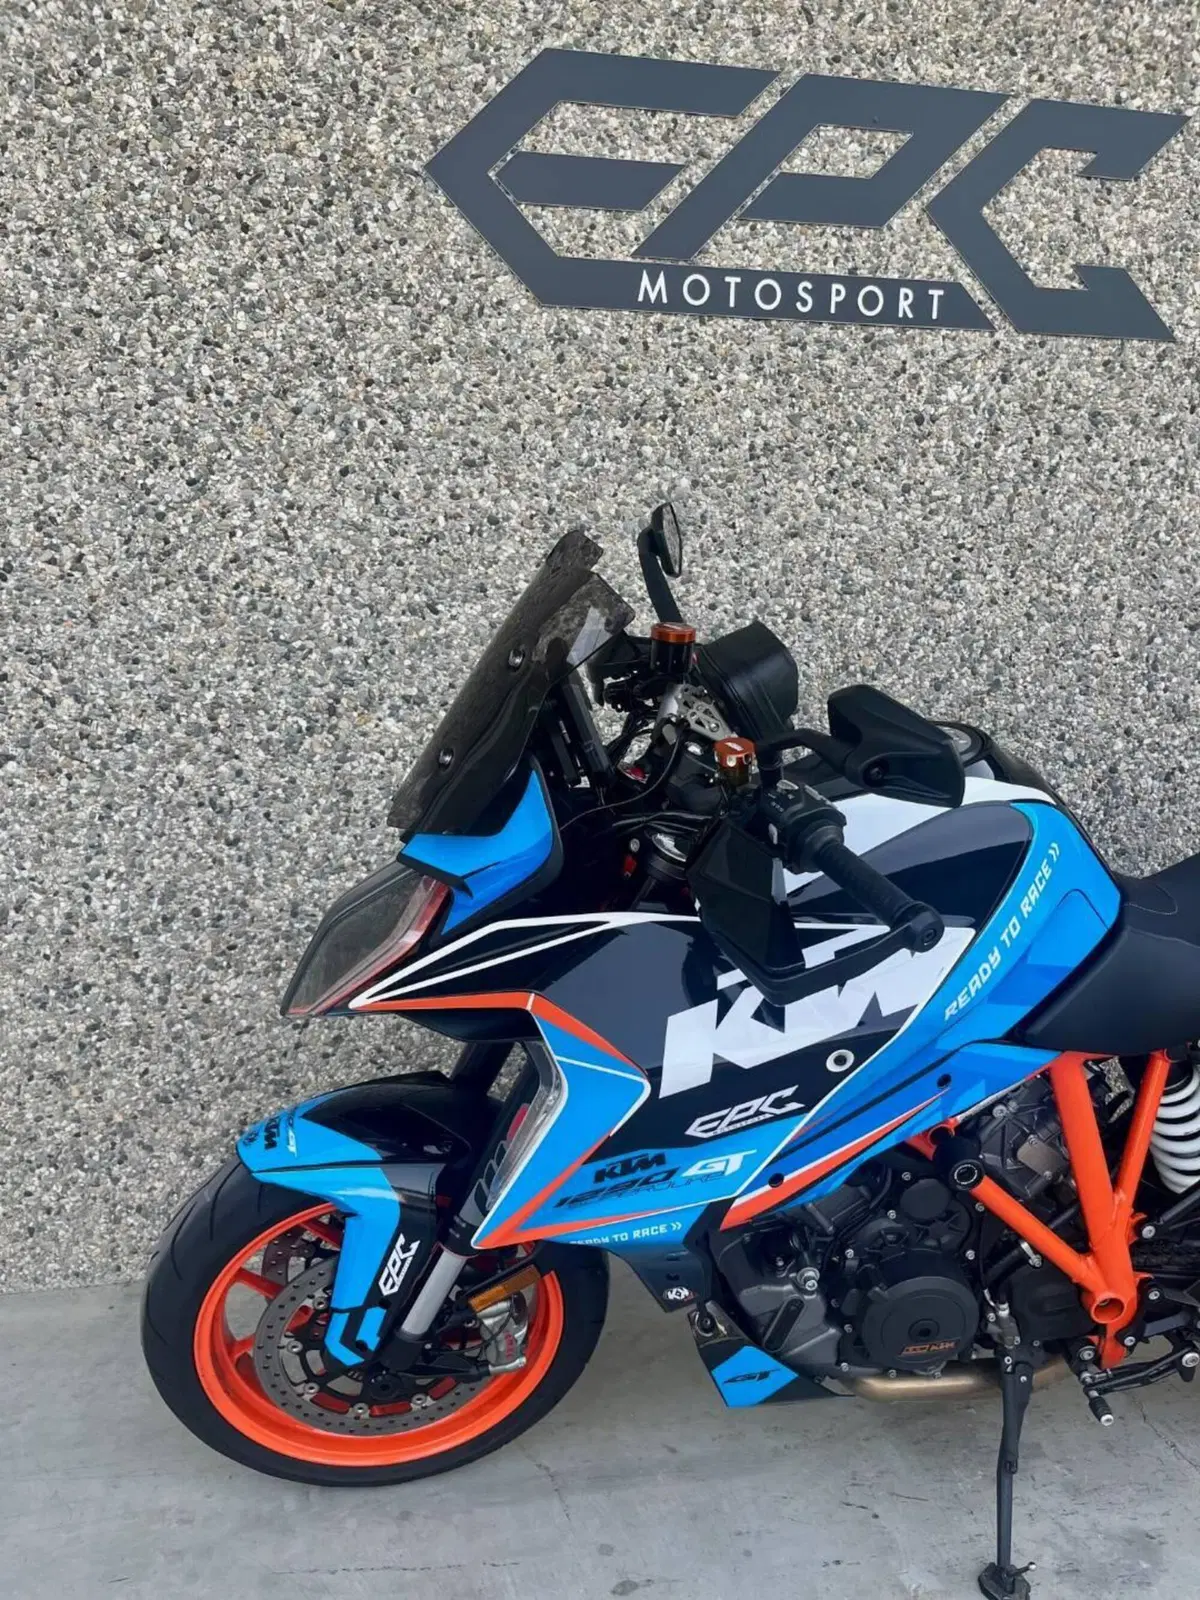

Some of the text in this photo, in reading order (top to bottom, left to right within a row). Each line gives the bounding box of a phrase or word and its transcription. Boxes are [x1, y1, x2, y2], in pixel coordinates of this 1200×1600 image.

[424, 47, 1191, 342] EPC
[637, 269, 945, 321] MOTOSPORT
[944, 859, 1052, 1021] READY TO RACE
[684, 1084, 806, 1138] EPC
[593, 1153, 667, 1183] KTM
[681, 1149, 757, 1177] GT
[612, 1231, 629, 1243] TO
[633, 1223, 668, 1241] RACE
[378, 1232, 421, 1297] EPC
